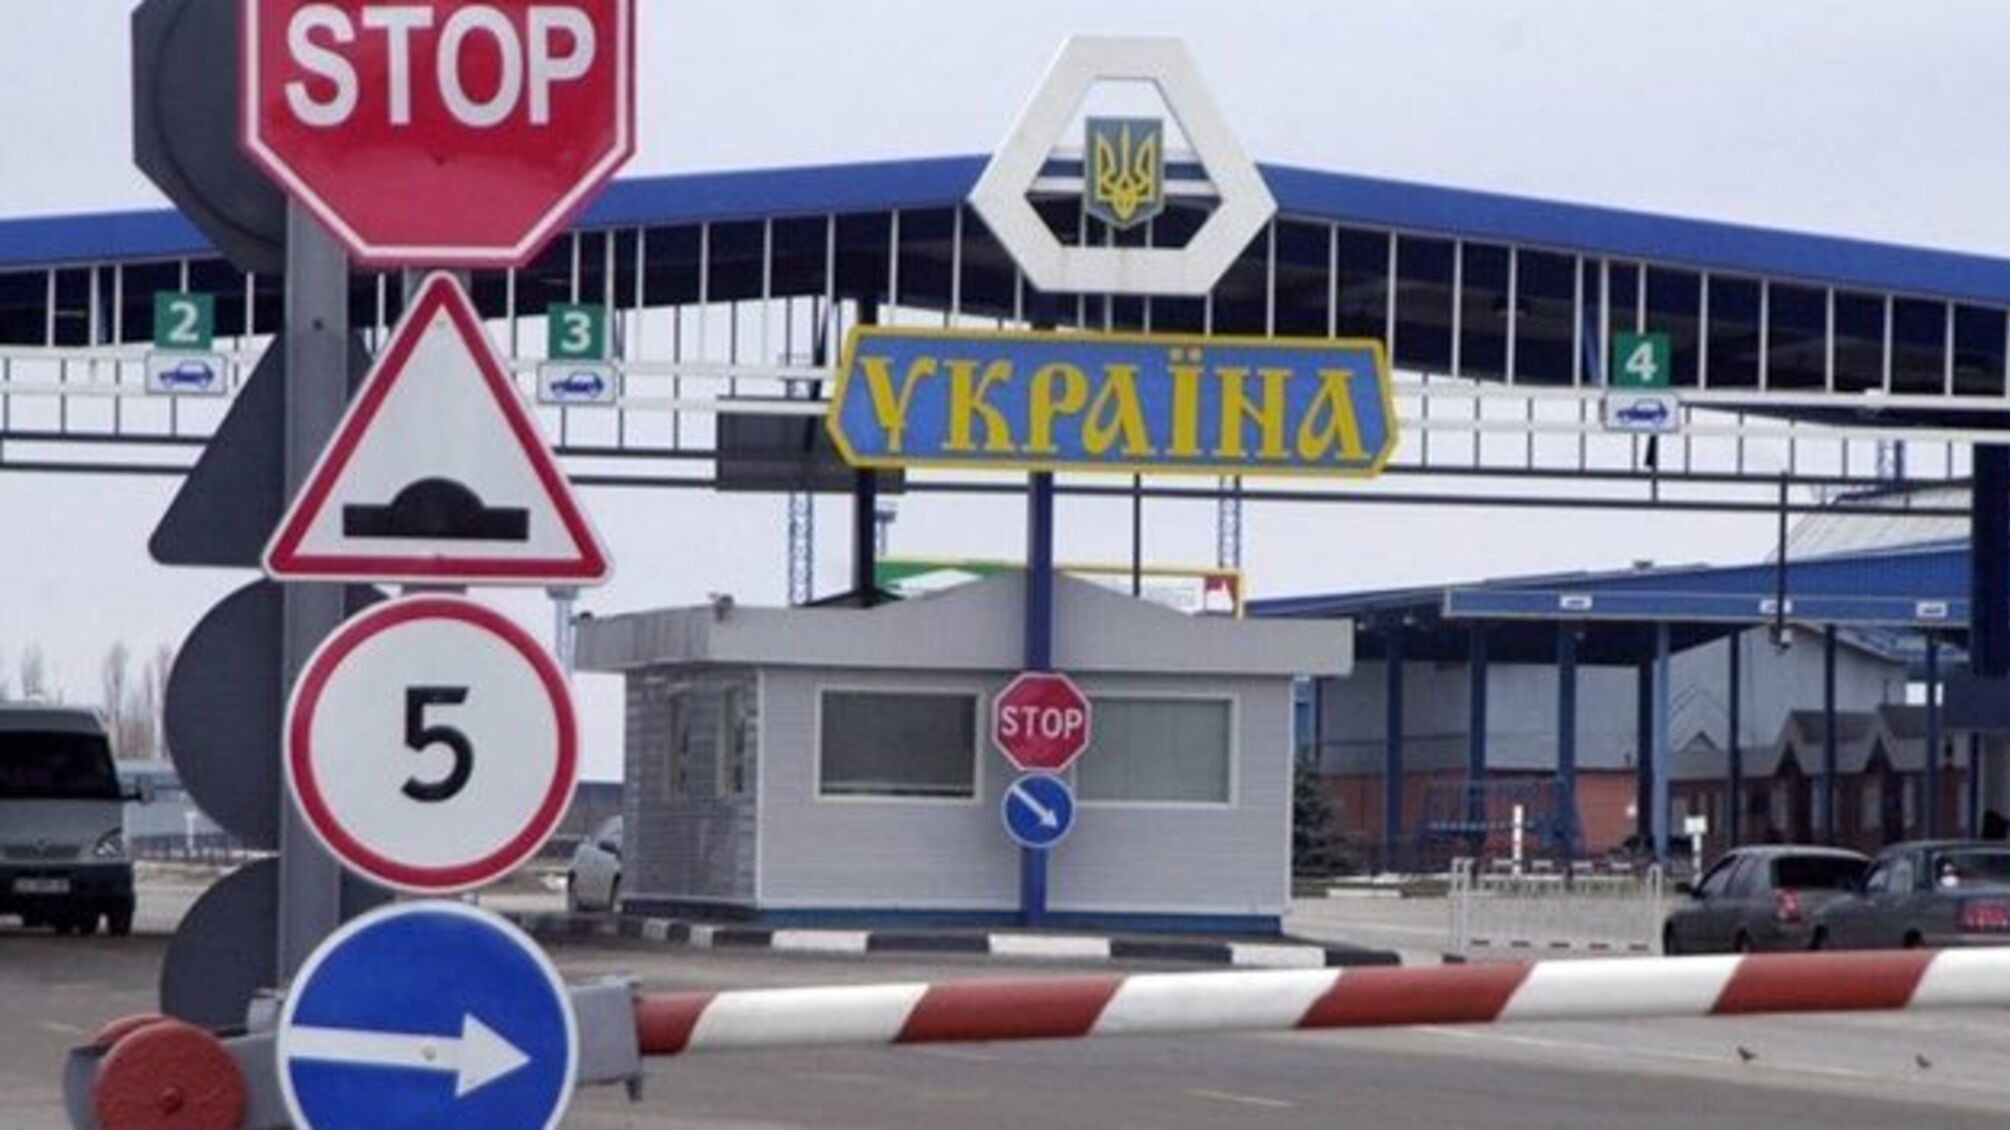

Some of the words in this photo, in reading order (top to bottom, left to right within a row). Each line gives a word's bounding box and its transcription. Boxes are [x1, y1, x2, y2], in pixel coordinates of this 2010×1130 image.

[285, 5, 596, 127] STOP
[168, 303, 199, 342] 2
[562, 312, 592, 352] 3
[1626, 342, 1657, 382] 4
[860, 347, 1371, 462] УКРАЇНА
[1000, 704, 1083, 740] STOP
[400, 686, 474, 804] 5
